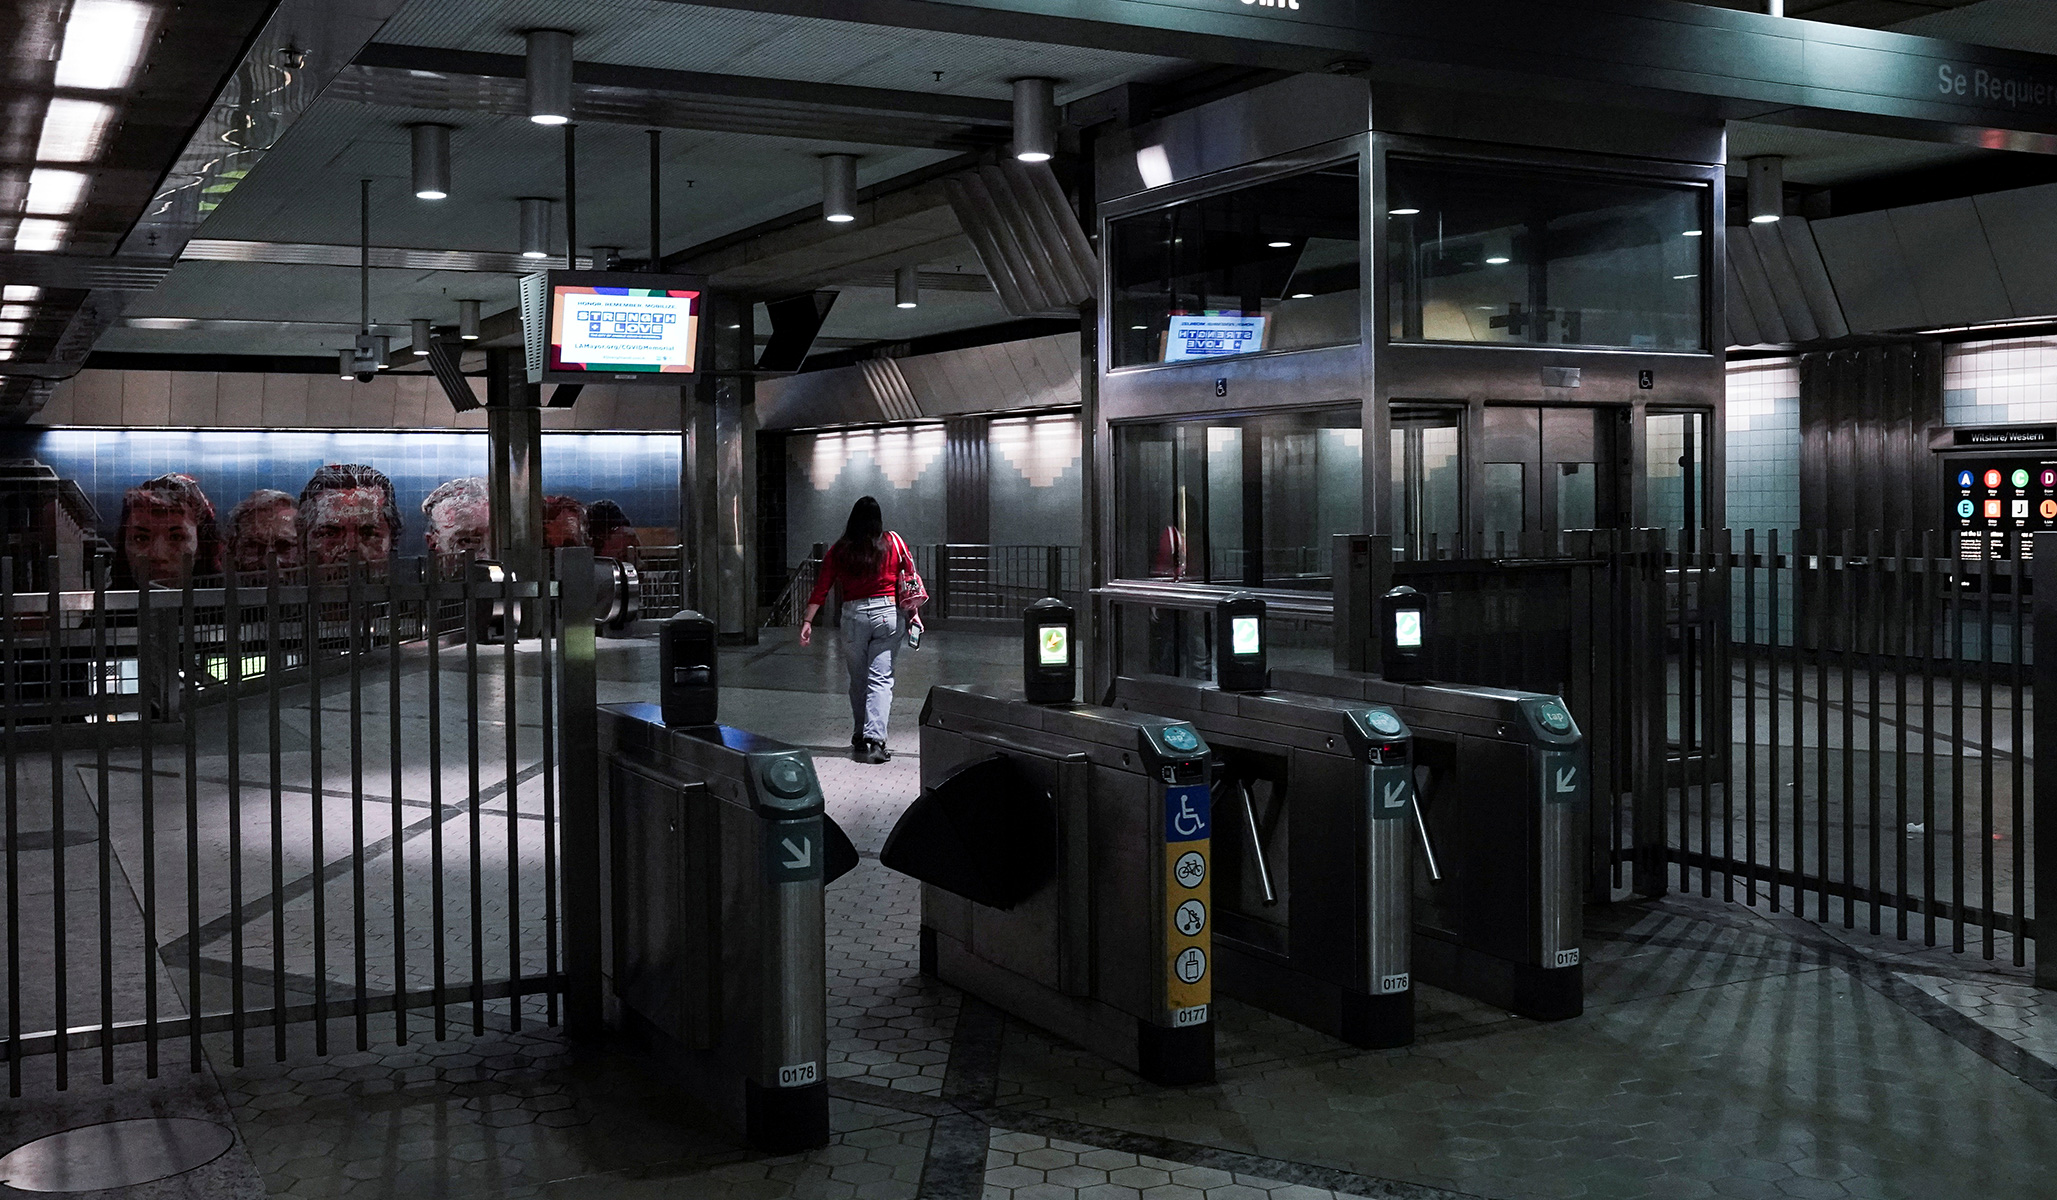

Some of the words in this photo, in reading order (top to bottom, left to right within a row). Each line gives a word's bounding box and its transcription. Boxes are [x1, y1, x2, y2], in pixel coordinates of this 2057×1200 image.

[1939, 64, 1967, 95] Se
[1975, 69, 2057, 108] Requier
[577, 311, 676, 323] STRENGTH
[614, 323, 663, 333] LOVE
[1971, 432, 2045, 443] Wilshire/Western
[1961, 473, 1971, 485] A
[1988, 473, 1998, 485] B
[2016, 473, 2024, 485] C
[2045, 472, 2054, 484] D
[1962, 503, 1970, 514] E
[2017, 503, 2023, 514] J
[2046, 503, 2053, 514] L
[1546, 713, 1564, 722] tap
[1164, 735, 1184, 743] tap
[1557, 951, 1578, 964] 0175
[1384, 976, 1407, 990] 0176
[1180, 1008, 1205, 1023] 0177
[782, 1065, 814, 1083] 0178
